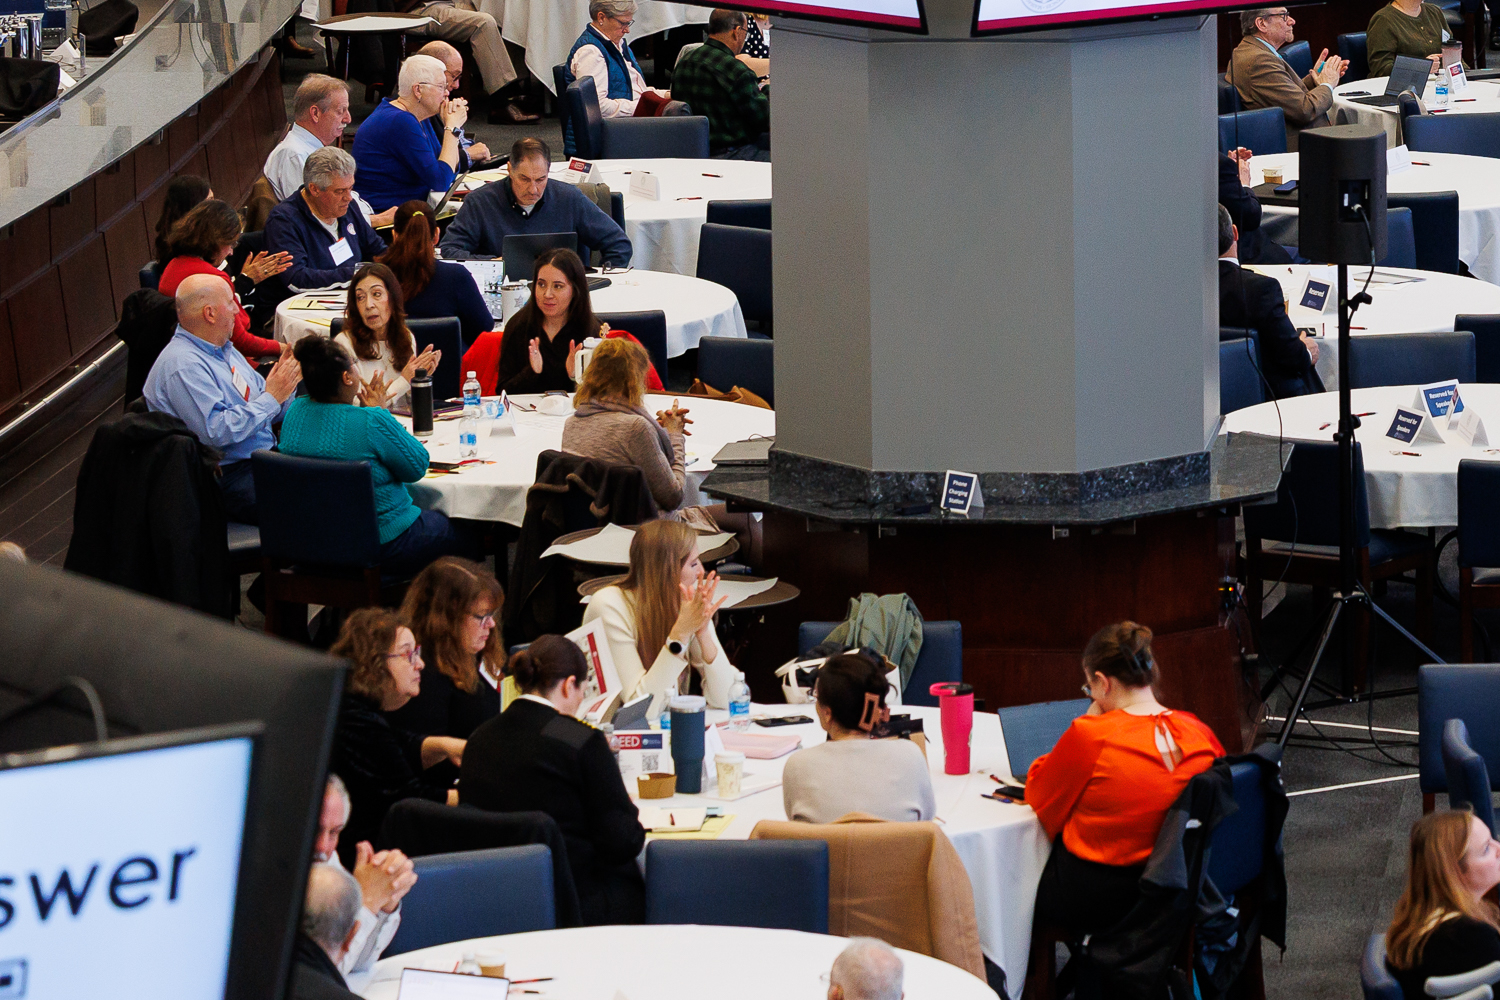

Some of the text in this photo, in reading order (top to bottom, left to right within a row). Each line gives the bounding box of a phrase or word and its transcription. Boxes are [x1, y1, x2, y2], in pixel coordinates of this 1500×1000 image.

[949, 488, 968, 497] Charging
[615, 736, 640, 747] EED
[0, 849, 196, 928] swer
